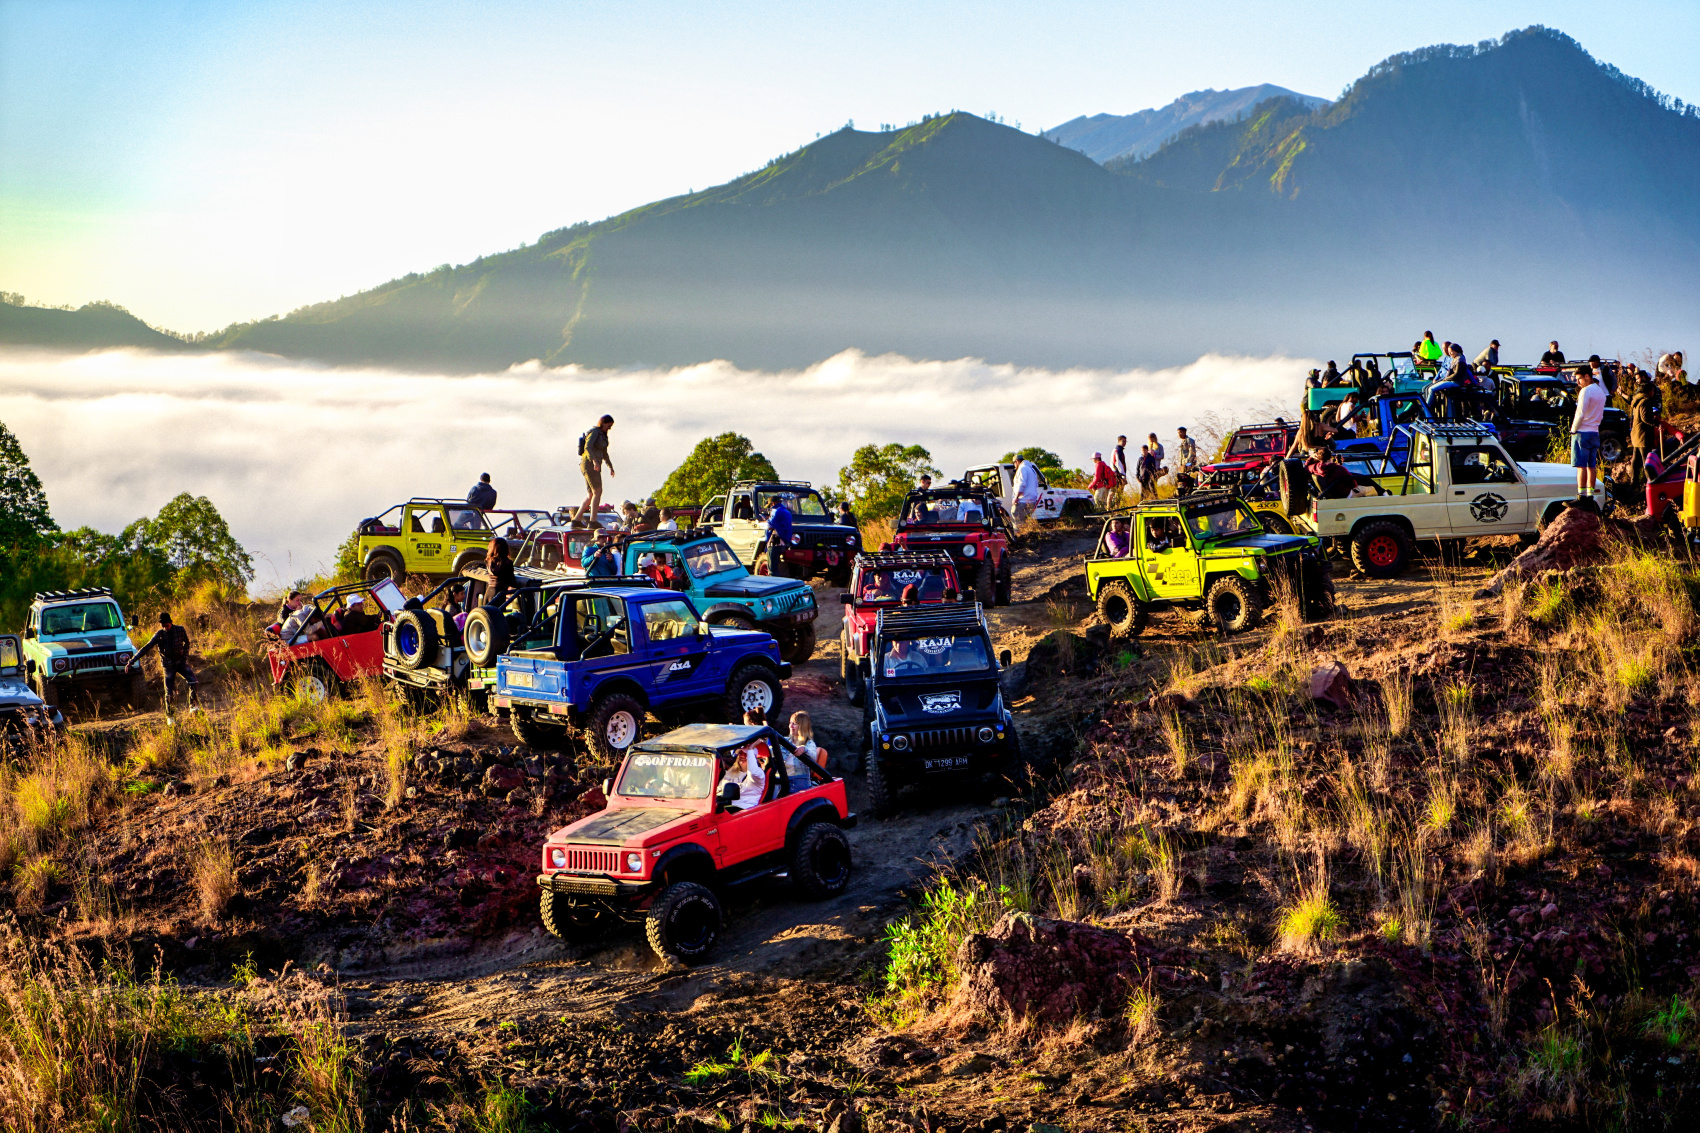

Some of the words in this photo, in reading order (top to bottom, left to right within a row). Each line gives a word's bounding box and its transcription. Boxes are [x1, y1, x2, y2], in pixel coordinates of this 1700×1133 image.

[893, 571, 922, 579] KAJA
[919, 637, 952, 648] KAJA
[669, 660, 691, 671] 4x4
[922, 702, 961, 711] KAJA
[651, 756, 707, 767] OFFROAD
